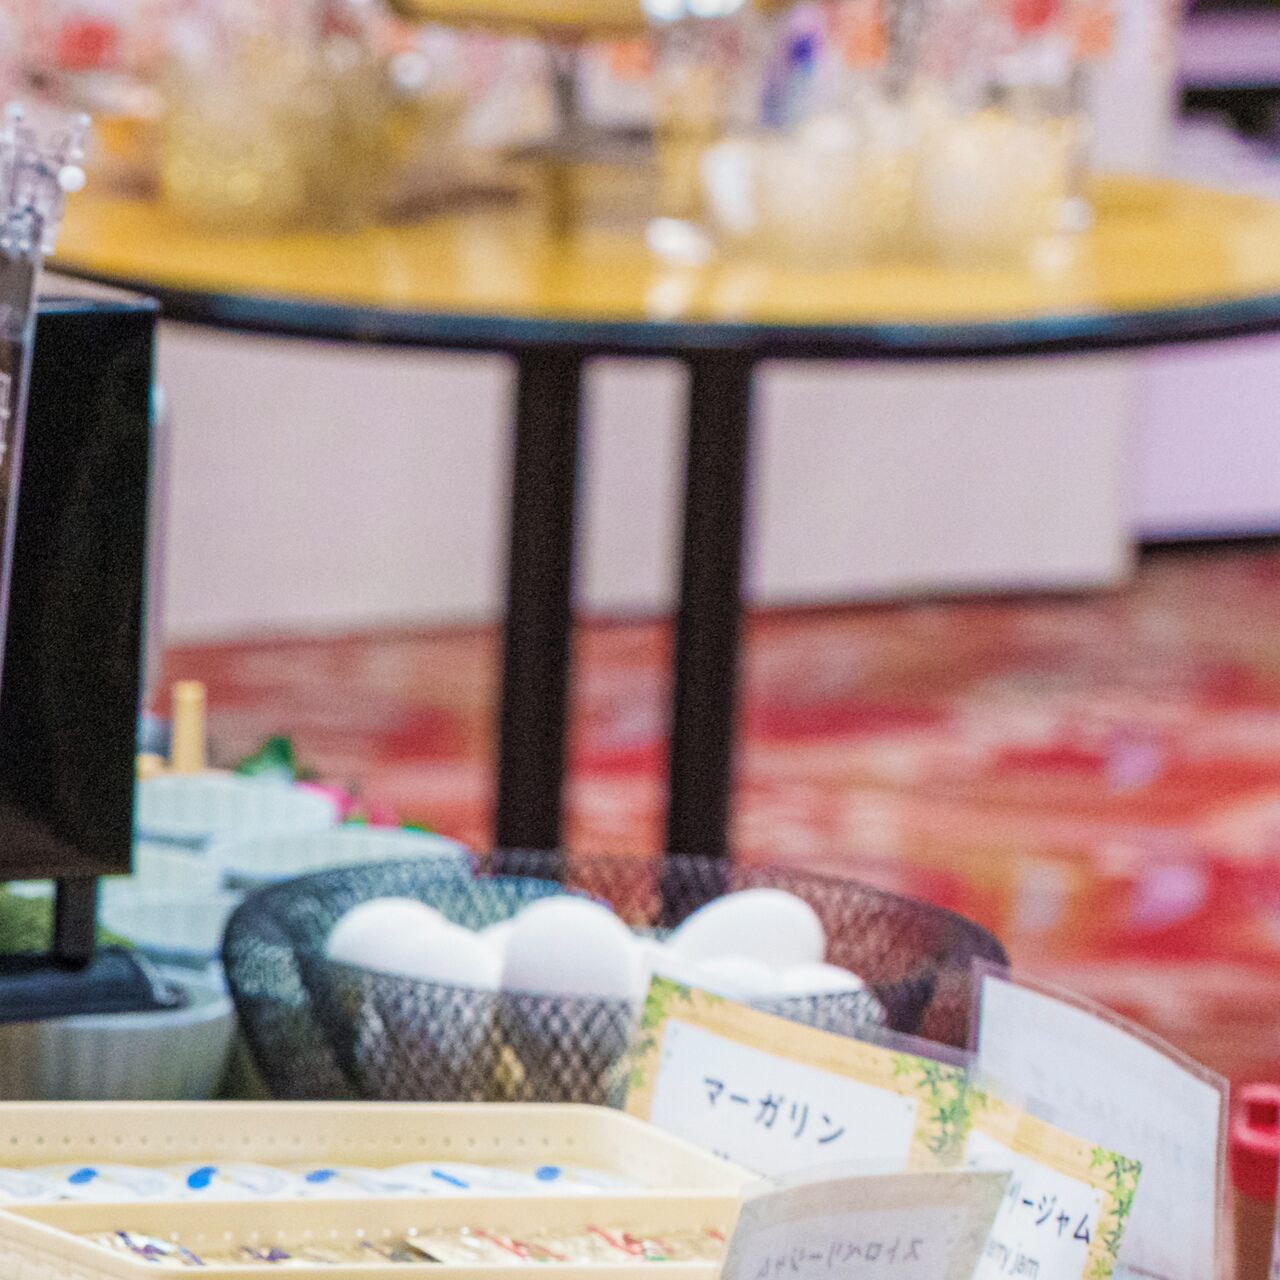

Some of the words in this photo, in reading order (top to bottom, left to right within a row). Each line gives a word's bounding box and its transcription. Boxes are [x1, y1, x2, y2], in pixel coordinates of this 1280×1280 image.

[703, 1076, 846, 1145] マーガリン
[1008, 1180, 1091, 1245] リージャム
[1007, 1243, 1041, 1280] jam
